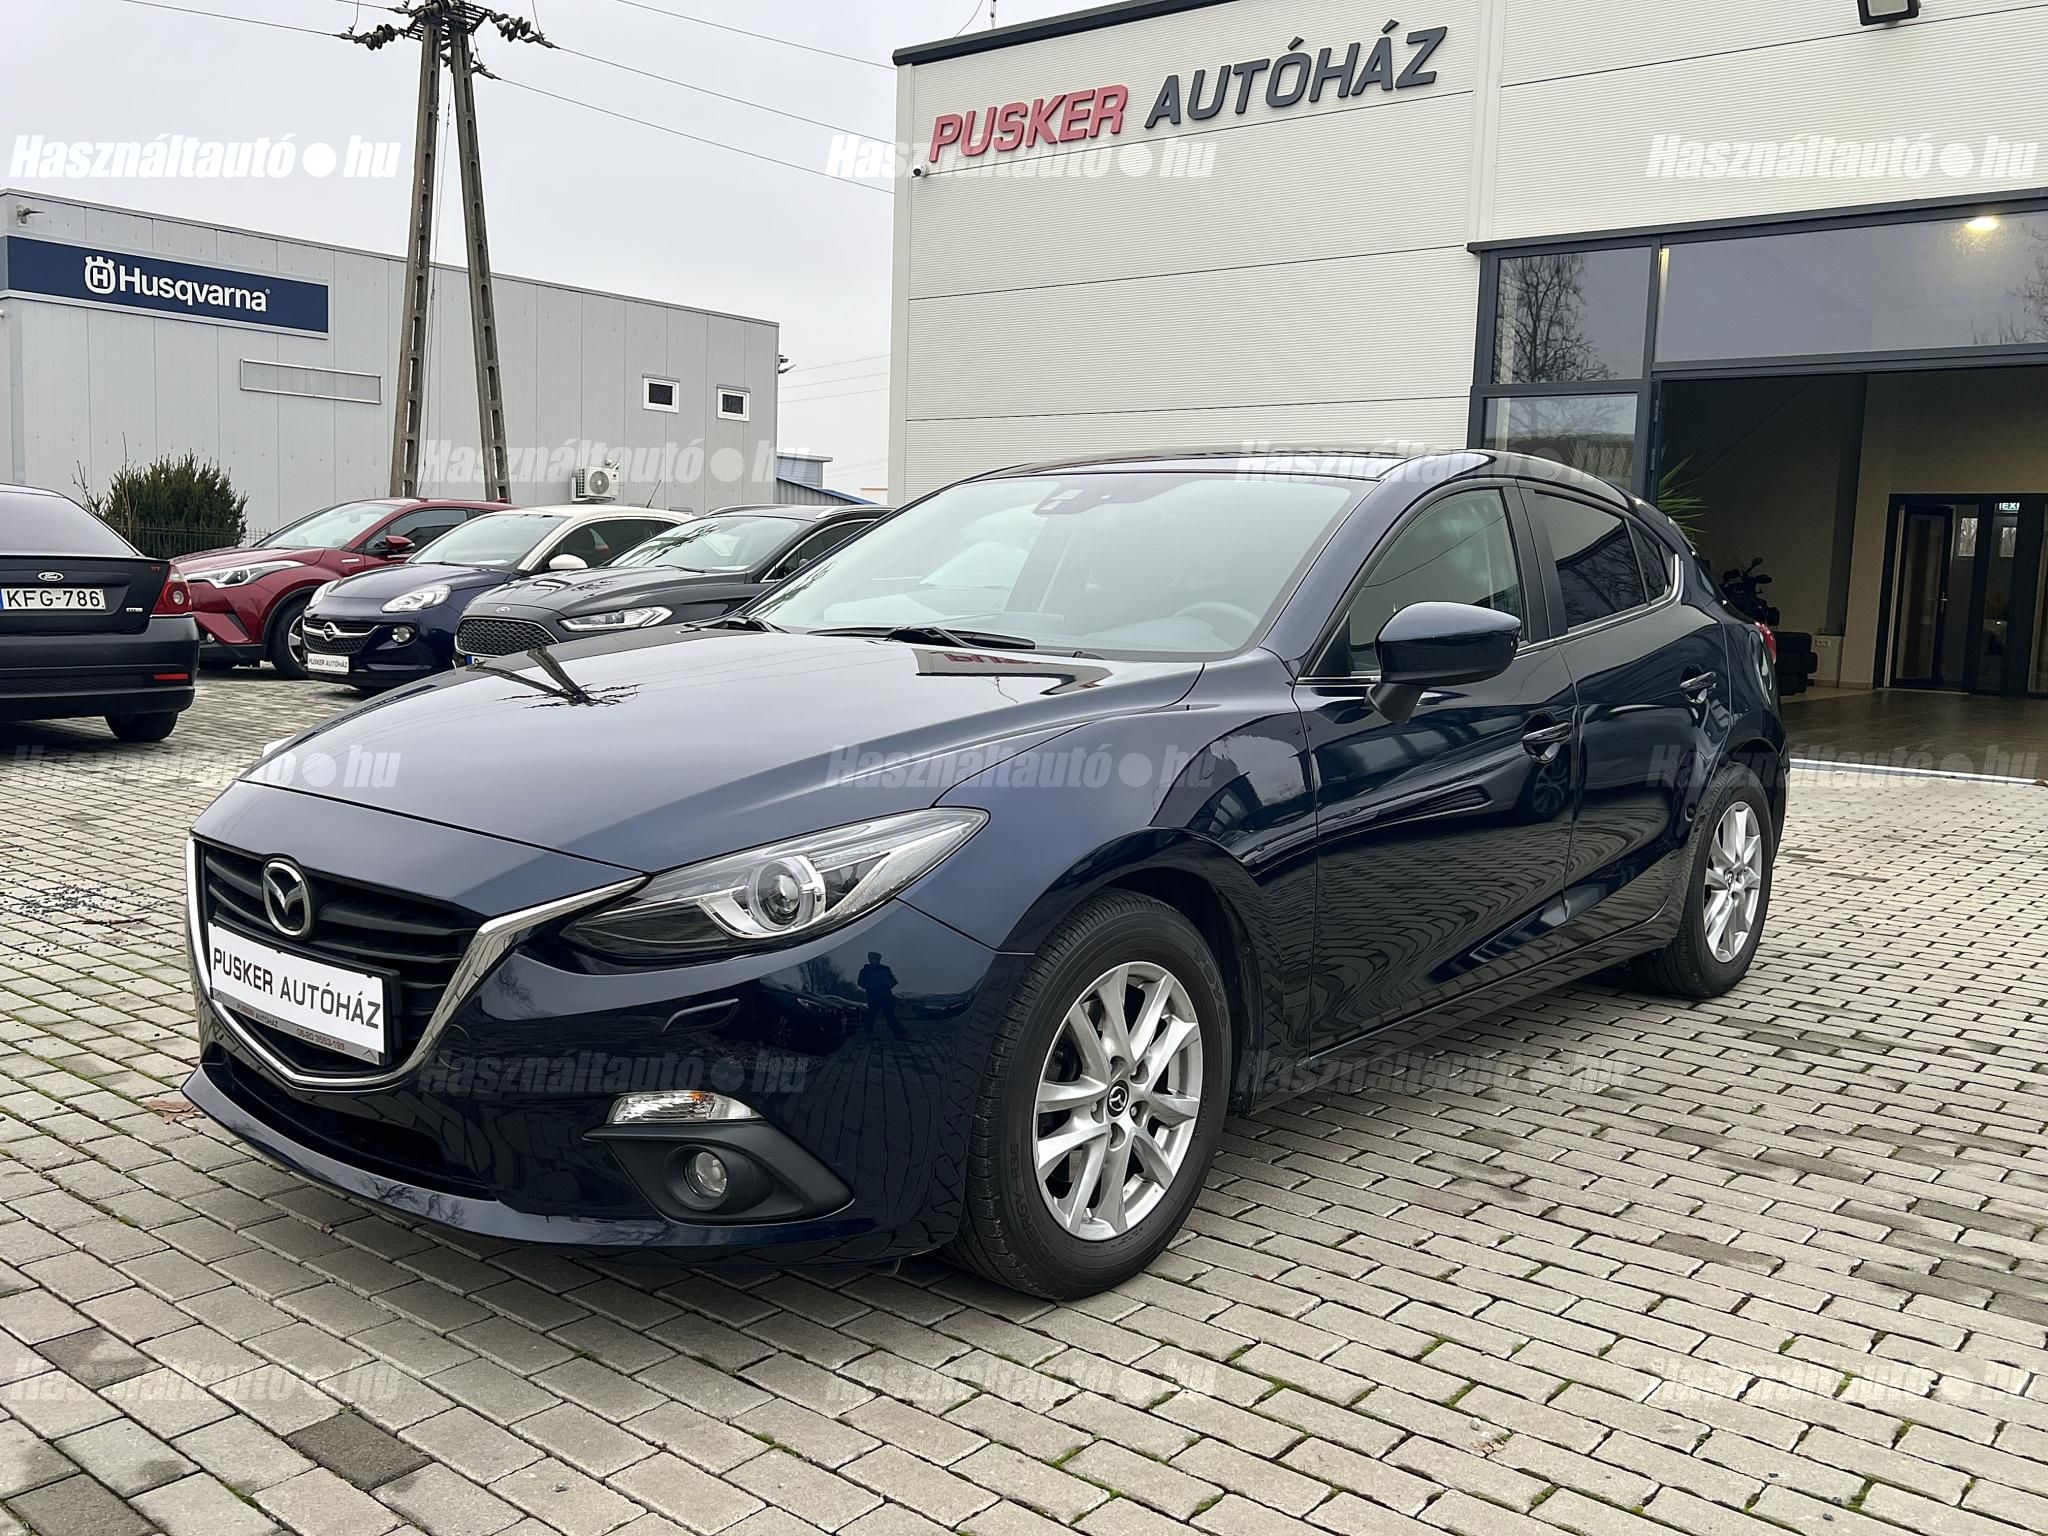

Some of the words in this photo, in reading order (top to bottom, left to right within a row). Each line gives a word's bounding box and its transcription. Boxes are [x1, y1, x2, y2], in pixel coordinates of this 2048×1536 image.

[928, 84, 1128, 162] PUSKER
[1145, 19, 1447, 129] AUTÓHÁZ
[7, 590, 100, 607] KFG-786
[213, 947, 273, 995] PUSKER
[280, 976, 381, 1030] AUTÓHÁZ
